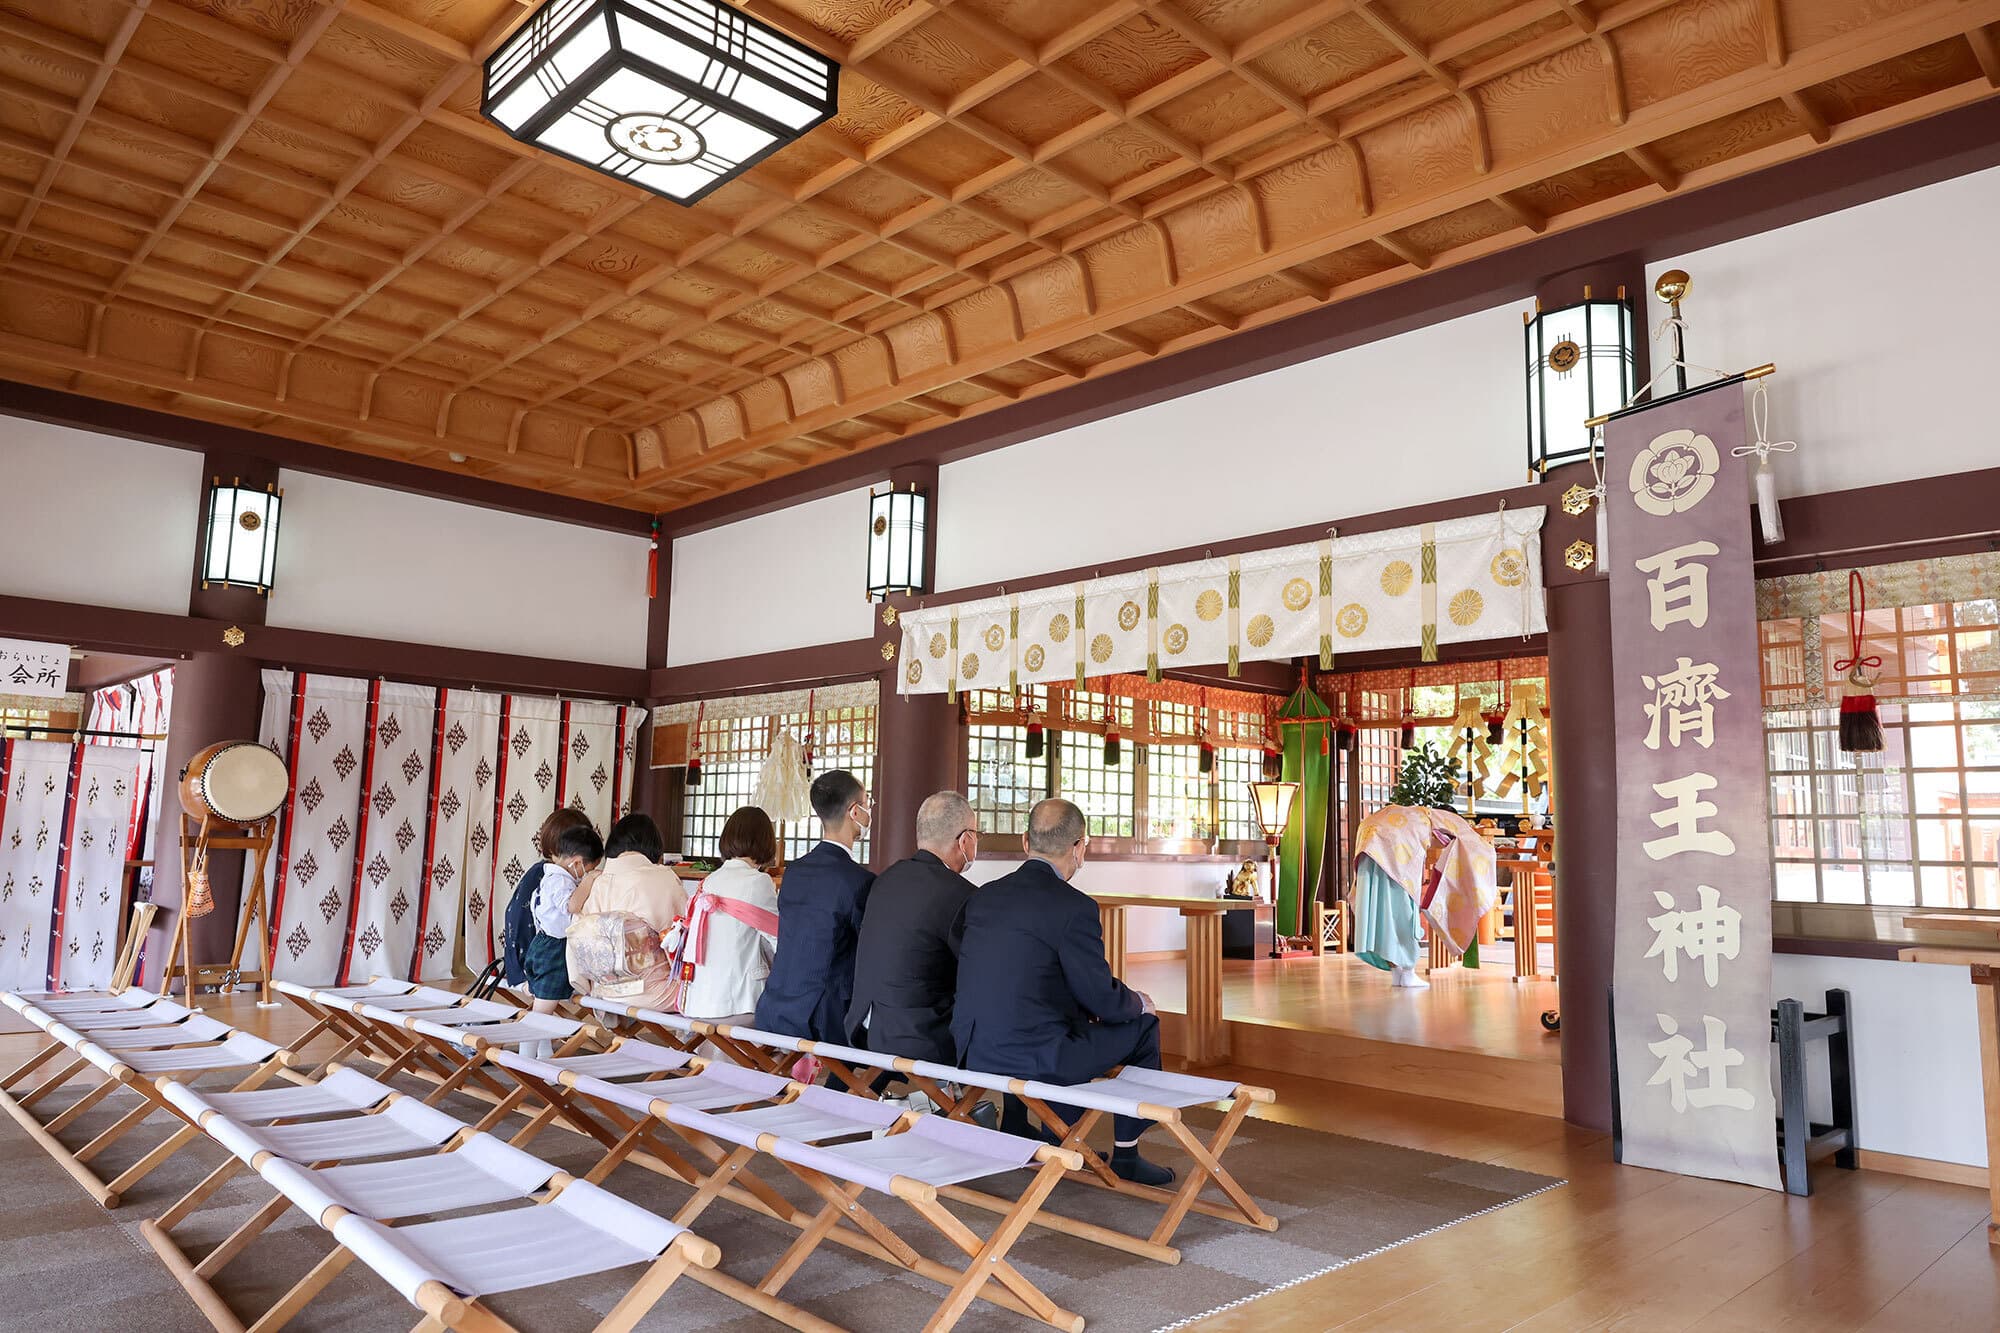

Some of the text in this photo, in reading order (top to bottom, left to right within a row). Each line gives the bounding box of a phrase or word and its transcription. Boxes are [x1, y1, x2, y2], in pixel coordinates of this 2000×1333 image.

[0, 664, 61, 688] 会所
[1634, 540, 1756, 1113] 百濟王神社
